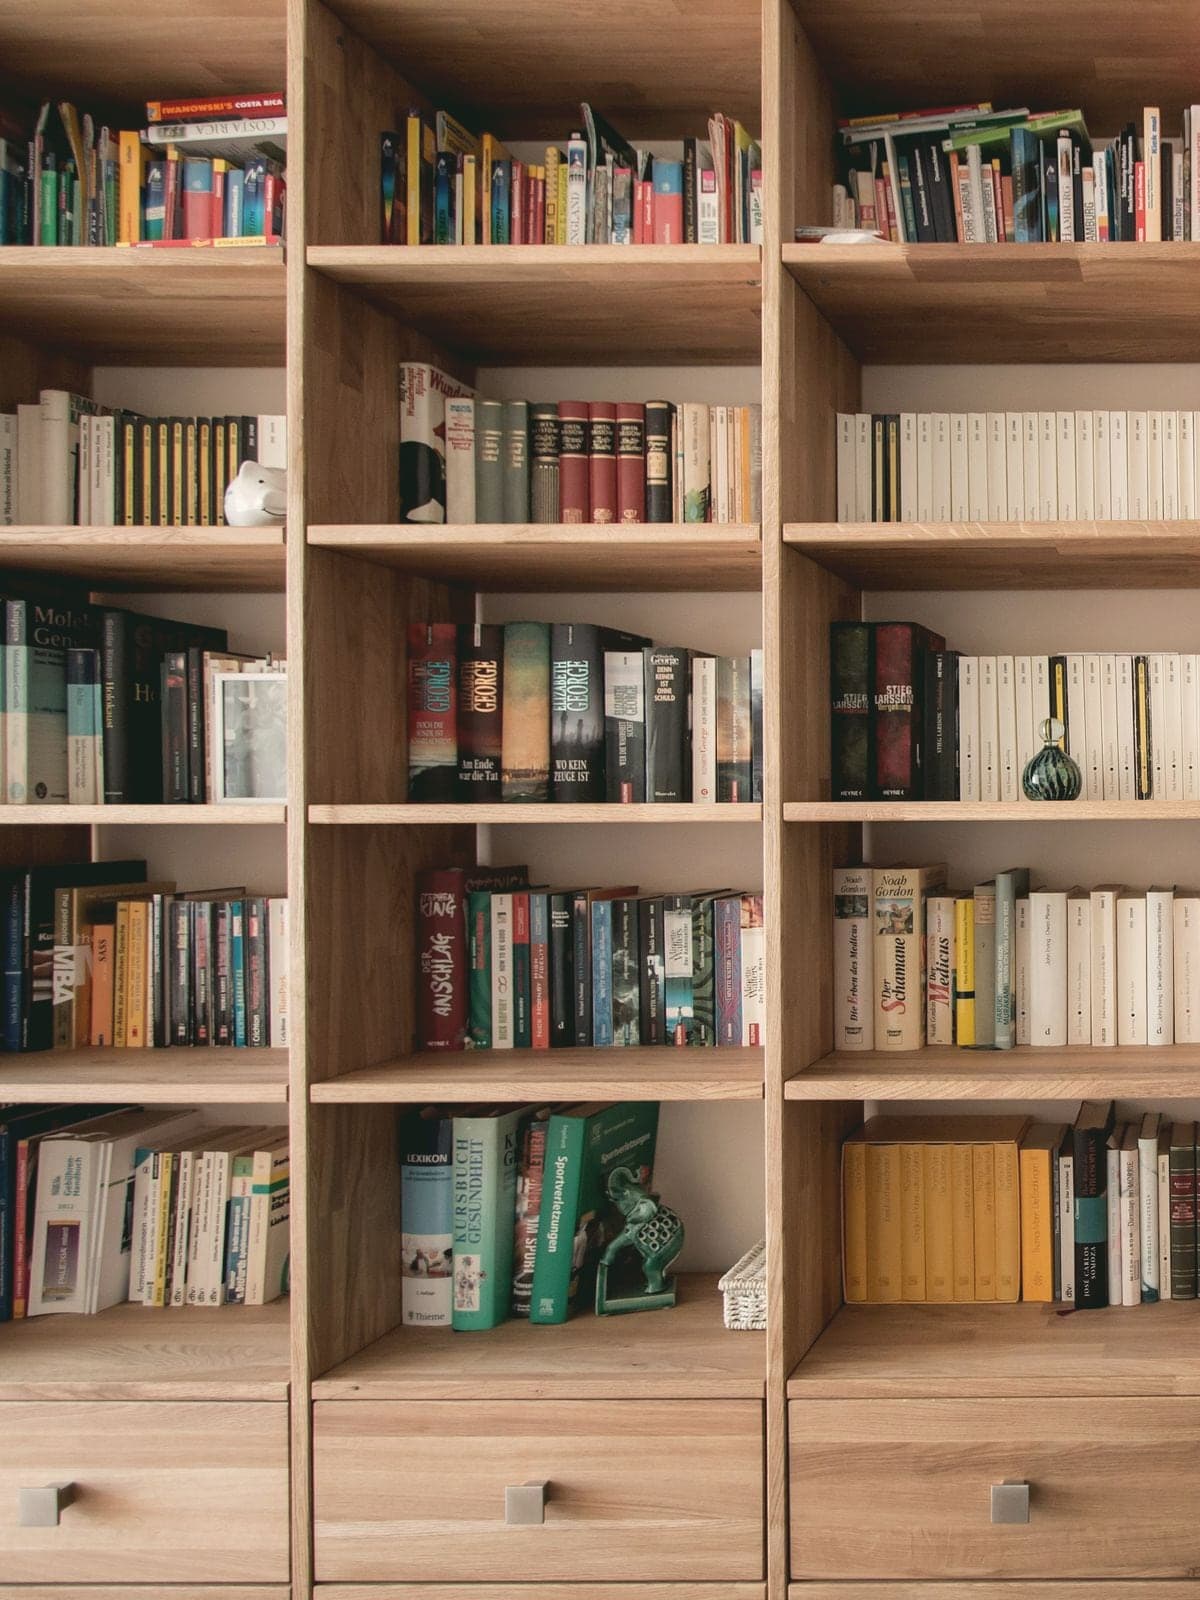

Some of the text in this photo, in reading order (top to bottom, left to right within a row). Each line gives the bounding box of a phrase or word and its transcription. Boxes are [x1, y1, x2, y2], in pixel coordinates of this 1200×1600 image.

[235, 101, 263, 109] COSTA
[263, 98, 284, 107] RICA
[195, 119, 277, 136] COSTA RICA
[1060, 185, 1073, 242] HAMBURG
[1173, 198, 1184, 237] Hamburg
[11, 604, 22, 642] Knippers
[105, 618, 114, 647] Guido
[650, 655, 680, 666] George
[427, 661, 451, 712] GEORGE
[474, 660, 498, 712] GEORGE
[552, 660, 567, 712] ELIZABETH
[566, 660, 590, 712] GEORGE
[625, 684, 638, 717] GEORGE
[843, 693, 868, 703] STIEG
[875, 694, 914, 704] LARSSON
[886, 685, 912, 695] STIEG
[104, 681, 115, 729] Holokaust
[833, 700, 869, 709] LARSSON
[459, 770, 498, 781] war die Tat
[474, 758, 494, 770] Ende
[554, 771, 589, 781] ZEUGE IST
[555, 760, 587, 769] WO KEIN
[875, 886, 914, 897] Gordon
[882, 875, 907, 886] Noah
[61, 894, 71, 945] The personal
[97, 939, 107, 962] SASS
[117, 924, 127, 993] deutschen Sprache
[421, 948, 433, 974] DER
[53, 945, 76, 1005] MBA
[429, 932, 456, 1016] ANSCHLAG
[847, 924, 858, 1021] Die Erben des Medicus
[880, 937, 906, 1015] Schamane
[928, 936, 951, 1009] Medicus
[928, 968, 937, 981] Der
[881, 978, 892, 999] Der
[1002, 985, 1010, 1025] MURAKAMI
[252, 1014, 261, 1042] Crichton
[407, 1153, 448, 1163] LEXIKON
[1127, 1160, 1136, 1190] MORRIE
[455, 1138, 469, 1243] KURSBUCH
[468, 1138, 483, 1244] GESUNDHEIT
[547, 1155, 569, 1253] Sportverletzungen
[1082, 1246, 1091, 1297] JOSÉ CARLOS
[1089, 1246, 1097, 1280] SOMOZA
[1065, 1285, 1073, 1298] dtv
[416, 1312, 446, 1321] Thieme
